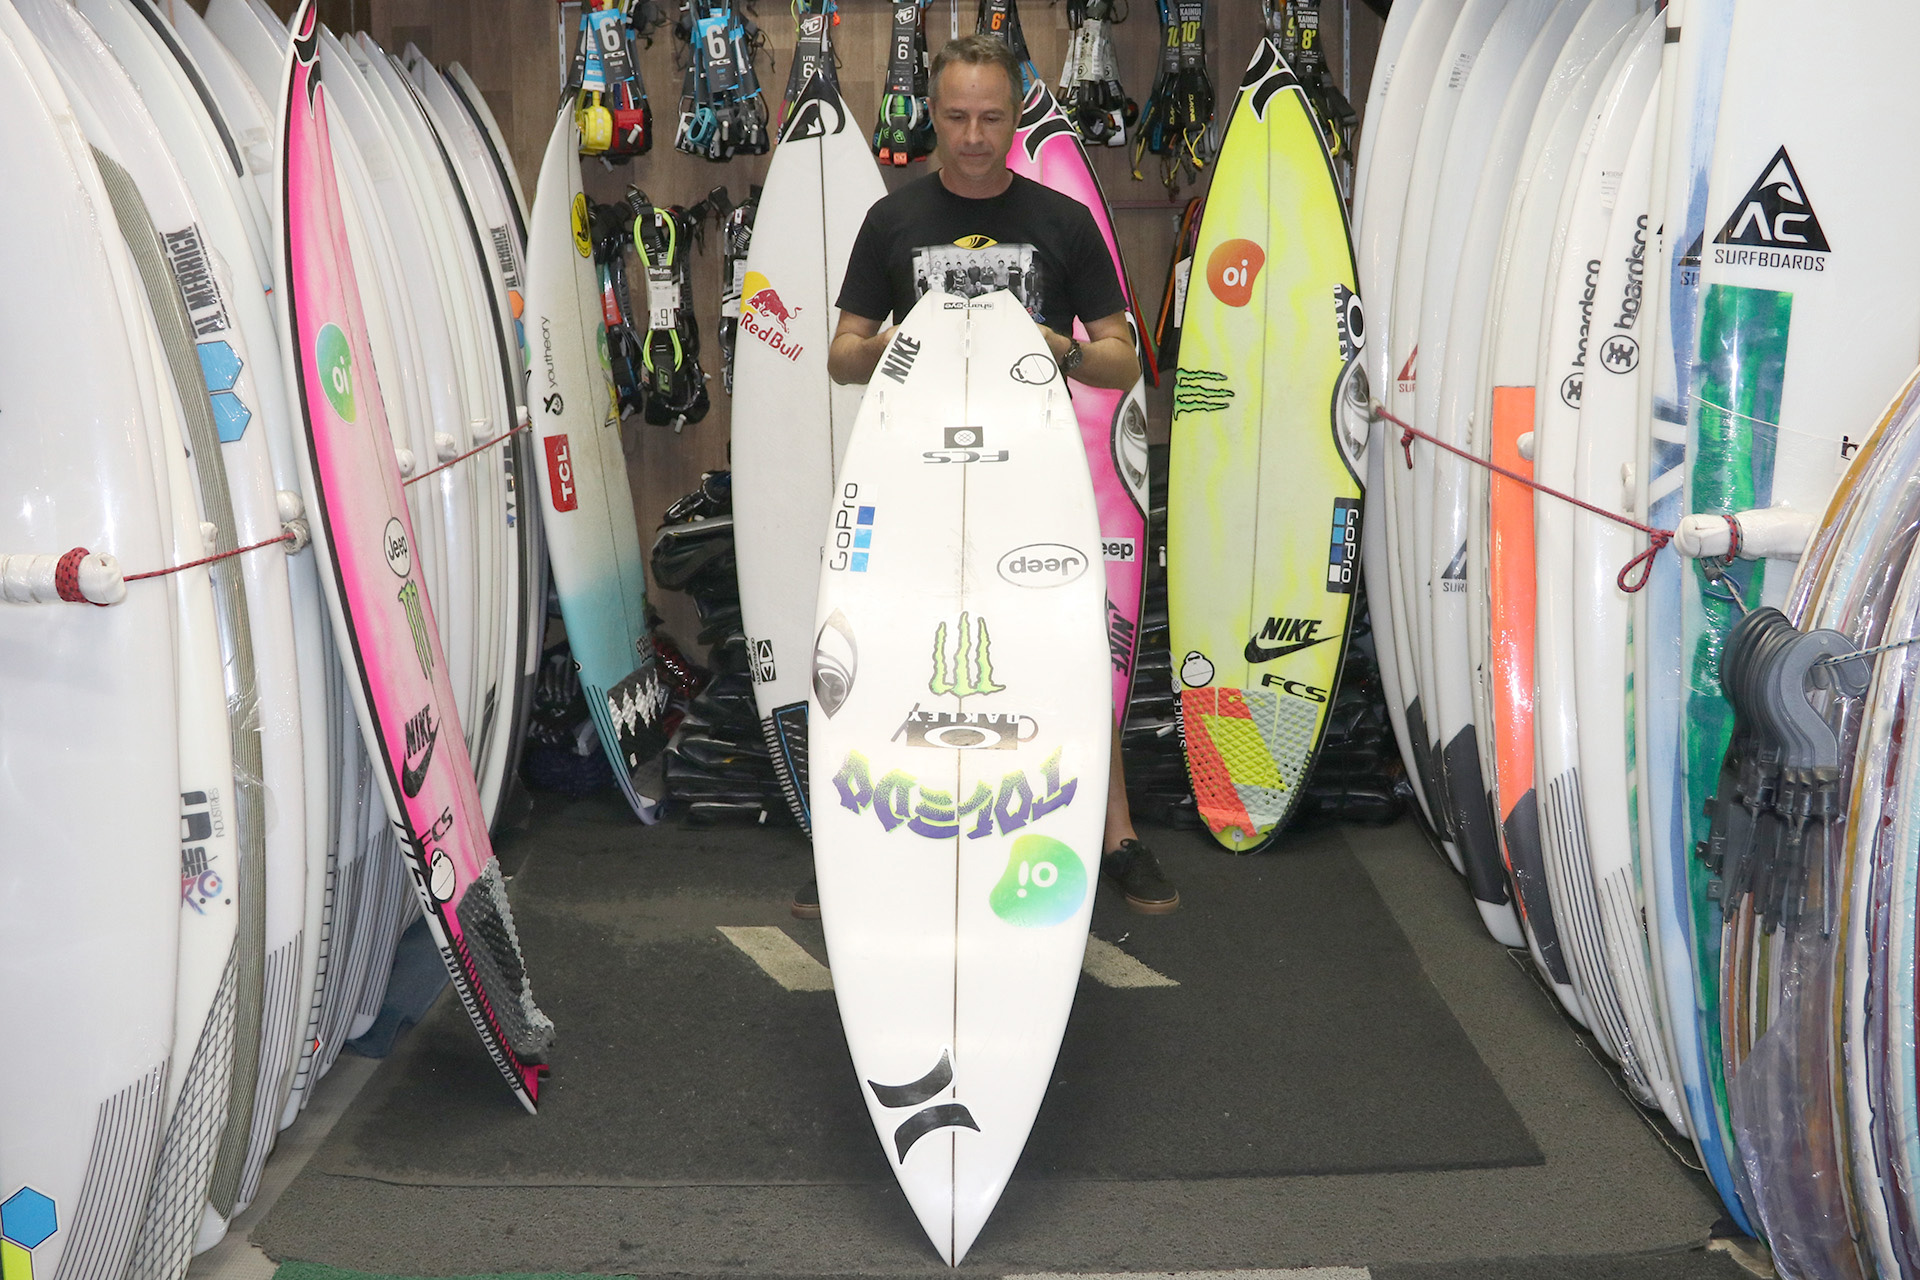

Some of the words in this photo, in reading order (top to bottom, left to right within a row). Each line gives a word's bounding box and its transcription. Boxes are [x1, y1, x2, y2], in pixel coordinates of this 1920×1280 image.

[709, 59, 731, 67] FCS
[898, 44, 908, 60] 6
[803, 62, 814, 78] 6
[165, 226, 219, 310] MERRICK
[1222, 259, 1249, 287] oi
[1714, 249, 1825, 272] SURFBOARDS
[197, 310, 228, 336] AL
[740, 312, 773, 342] Red
[768, 332, 803, 361] Bull
[1333, 283, 1349, 362] OAKLEY
[541, 316, 556, 388] youtheory
[881, 332, 921, 384] NIKE
[923, 450, 1009, 464] FCS
[557, 445, 573, 502] TCL
[830, 482, 858, 571] GoPro
[387, 533, 408, 561] Jeep
[1102, 542, 1134, 559] eep
[1341, 508, 1359, 584] GoPro
[1009, 556, 1080, 576] Jeep
[1260, 617, 1323, 642] NIKE
[1261, 673, 1327, 703] FCS
[405, 704, 433, 760] NIKE
[908, 711, 1020, 724] OAKLEY
[1174, 699, 1187, 747] STANCE
[832, 746, 1078, 840] TOLEDO
[1016, 860, 1058, 899] oi
